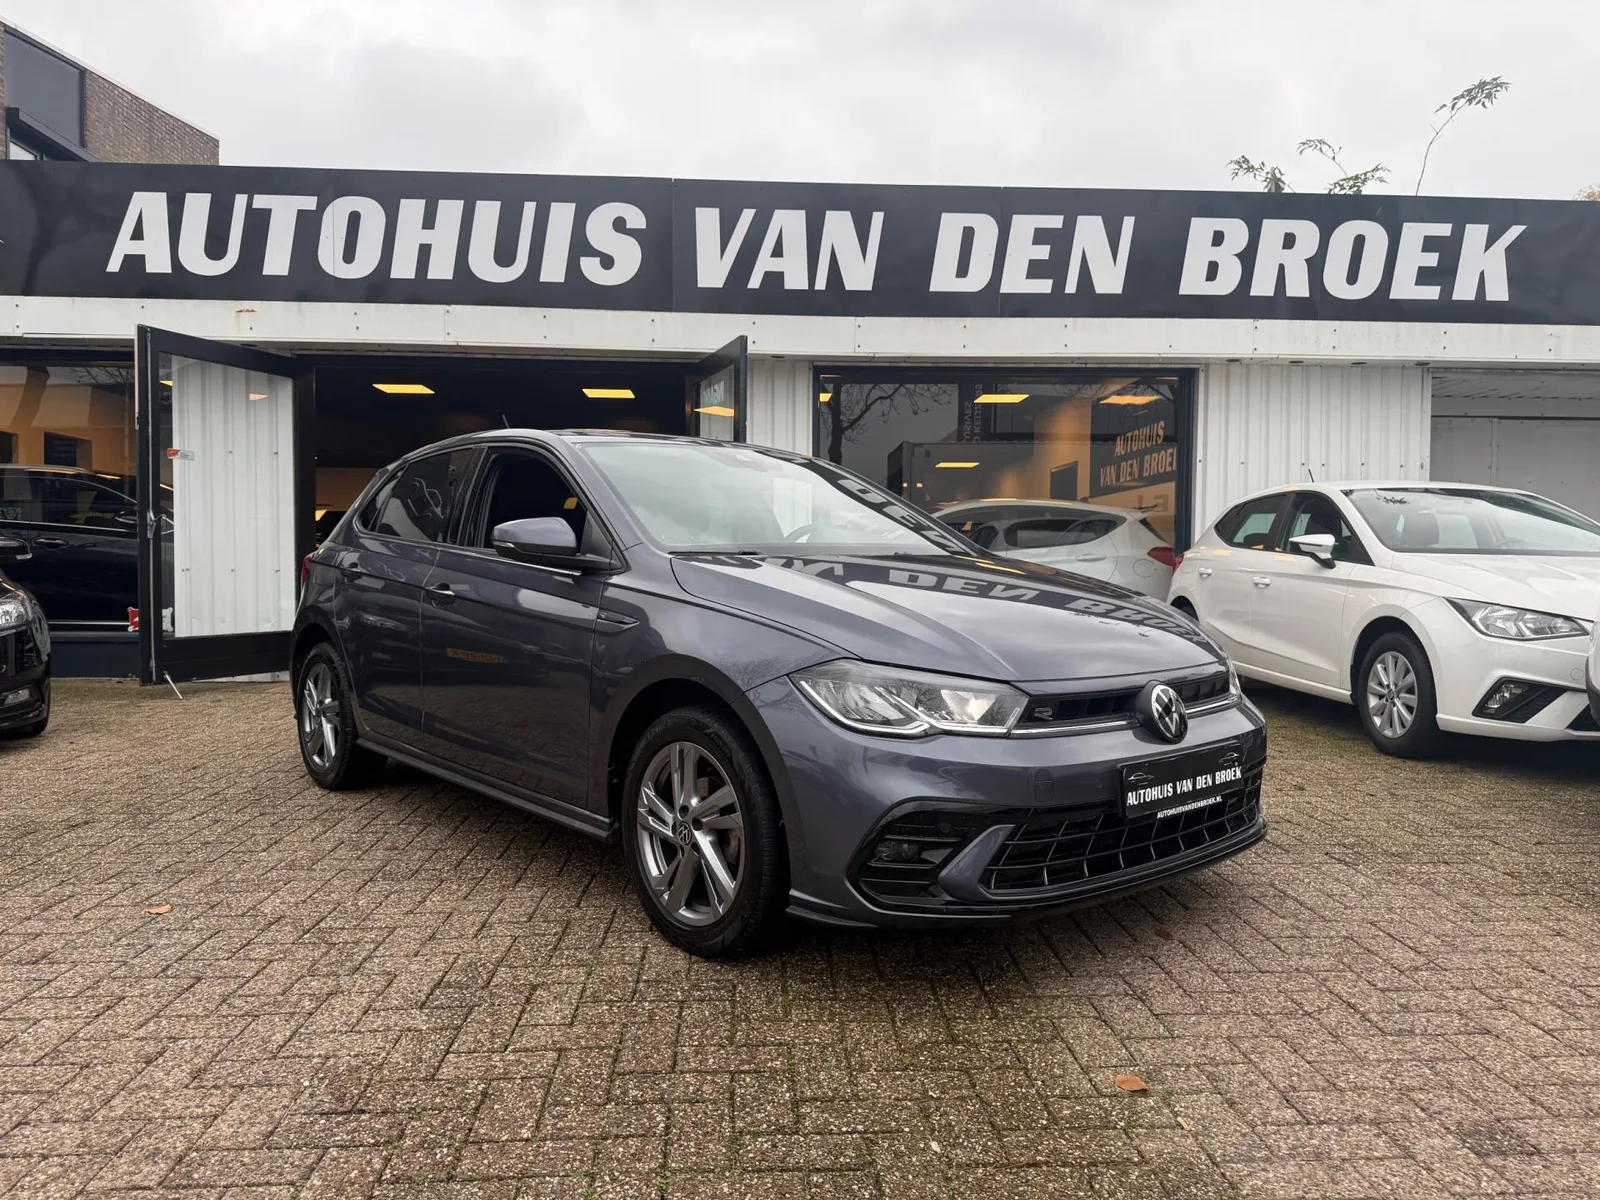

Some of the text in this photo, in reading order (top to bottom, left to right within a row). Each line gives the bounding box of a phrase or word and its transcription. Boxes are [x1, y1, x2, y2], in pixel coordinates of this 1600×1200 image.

[106, 191, 1528, 303] AUTOHUIS VAN DEN BROEK
[1114, 420, 1165, 457] AUTOHUIS
[1100, 463, 1117, 488] VAN
[1119, 457, 1140, 483] DEN
[1126, 766, 1242, 806] AUTOHUIS VAN DEN BROEK
[1156, 796, 1222, 819] AUTOHUISVANDENBROEK.NL
